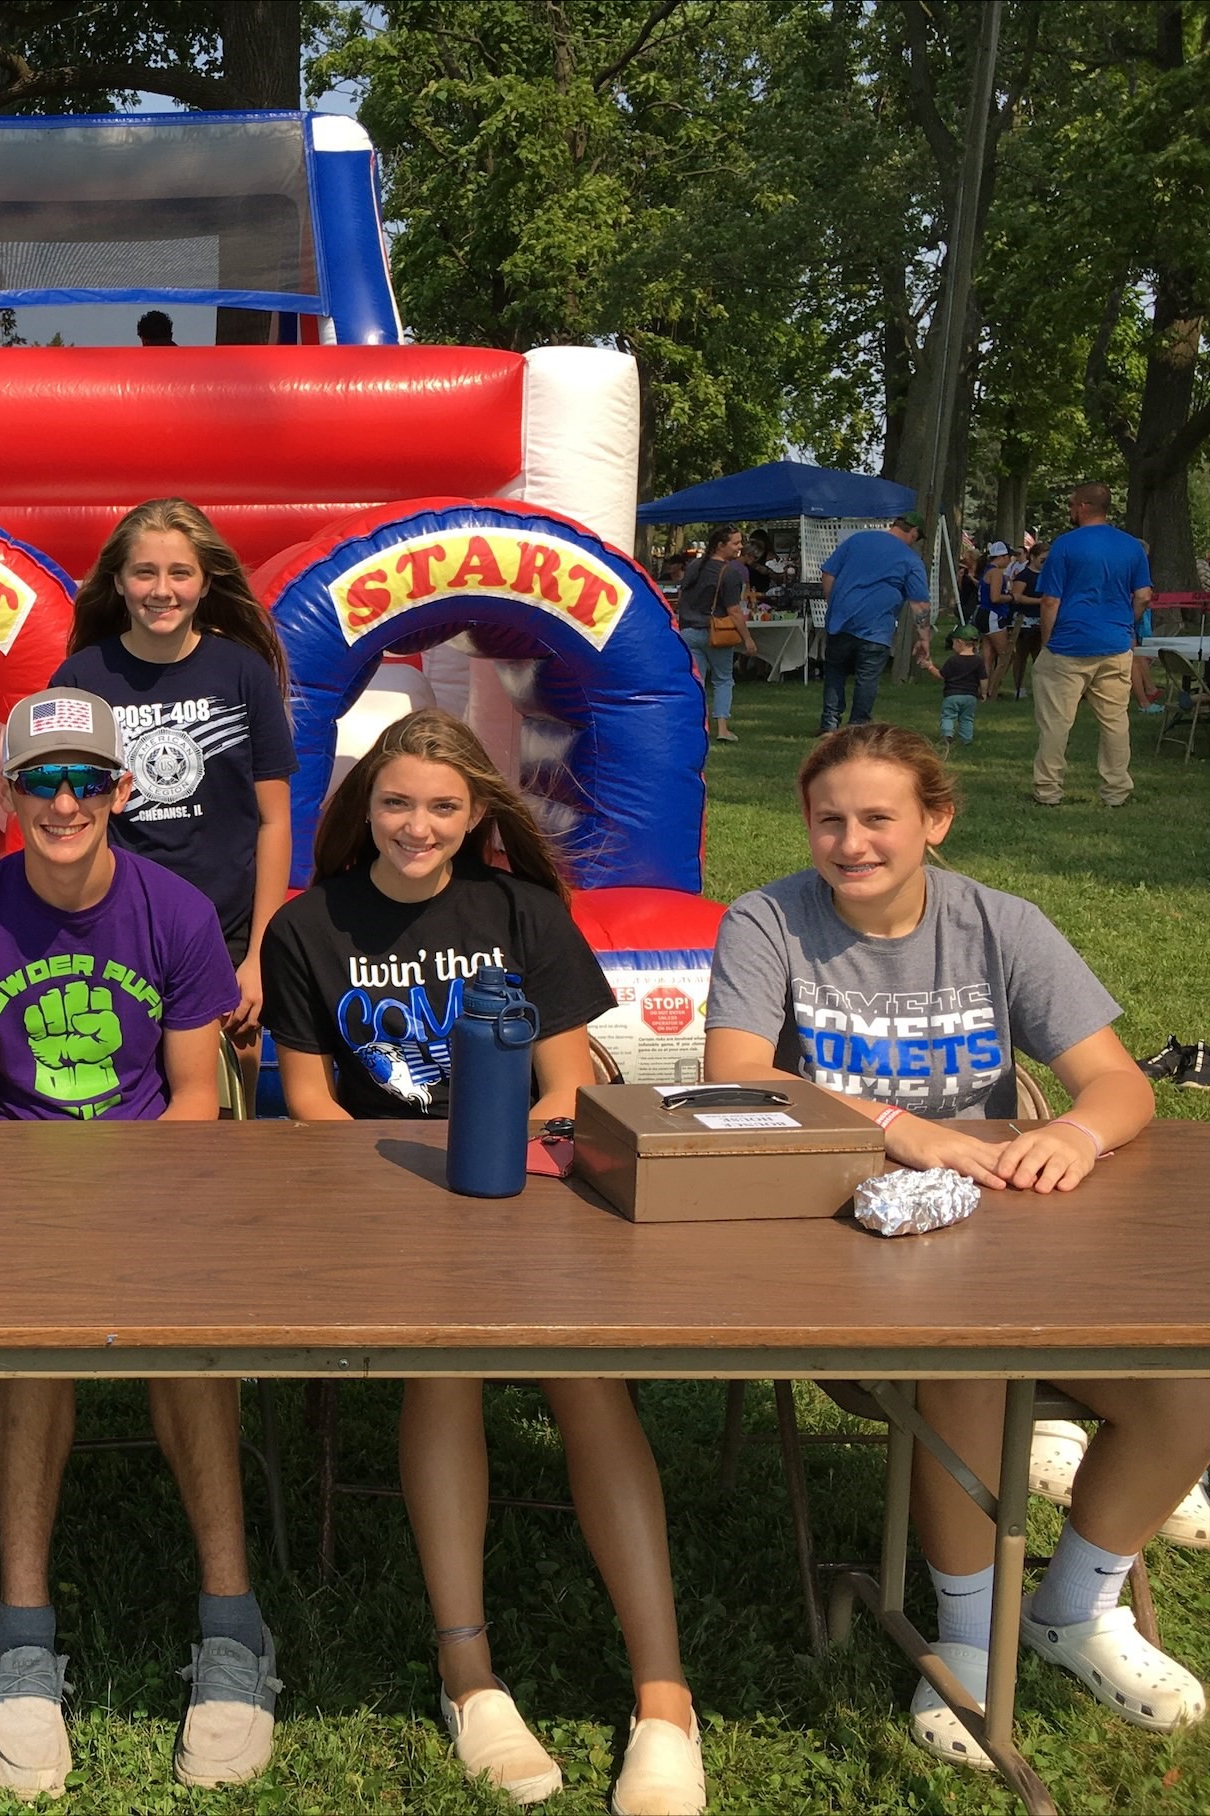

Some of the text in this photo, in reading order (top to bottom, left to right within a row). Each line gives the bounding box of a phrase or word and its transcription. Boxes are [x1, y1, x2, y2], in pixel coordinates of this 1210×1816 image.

[346, 535, 618, 628] START
[112, 698, 211, 728] POST 408
[137, 735, 194, 760] AMERICAN
[148, 781, 191, 796] LEGION
[193, 803, 204, 817] IL
[615, 987, 635, 1001] ES
[643, 997, 689, 1010] STOP!
